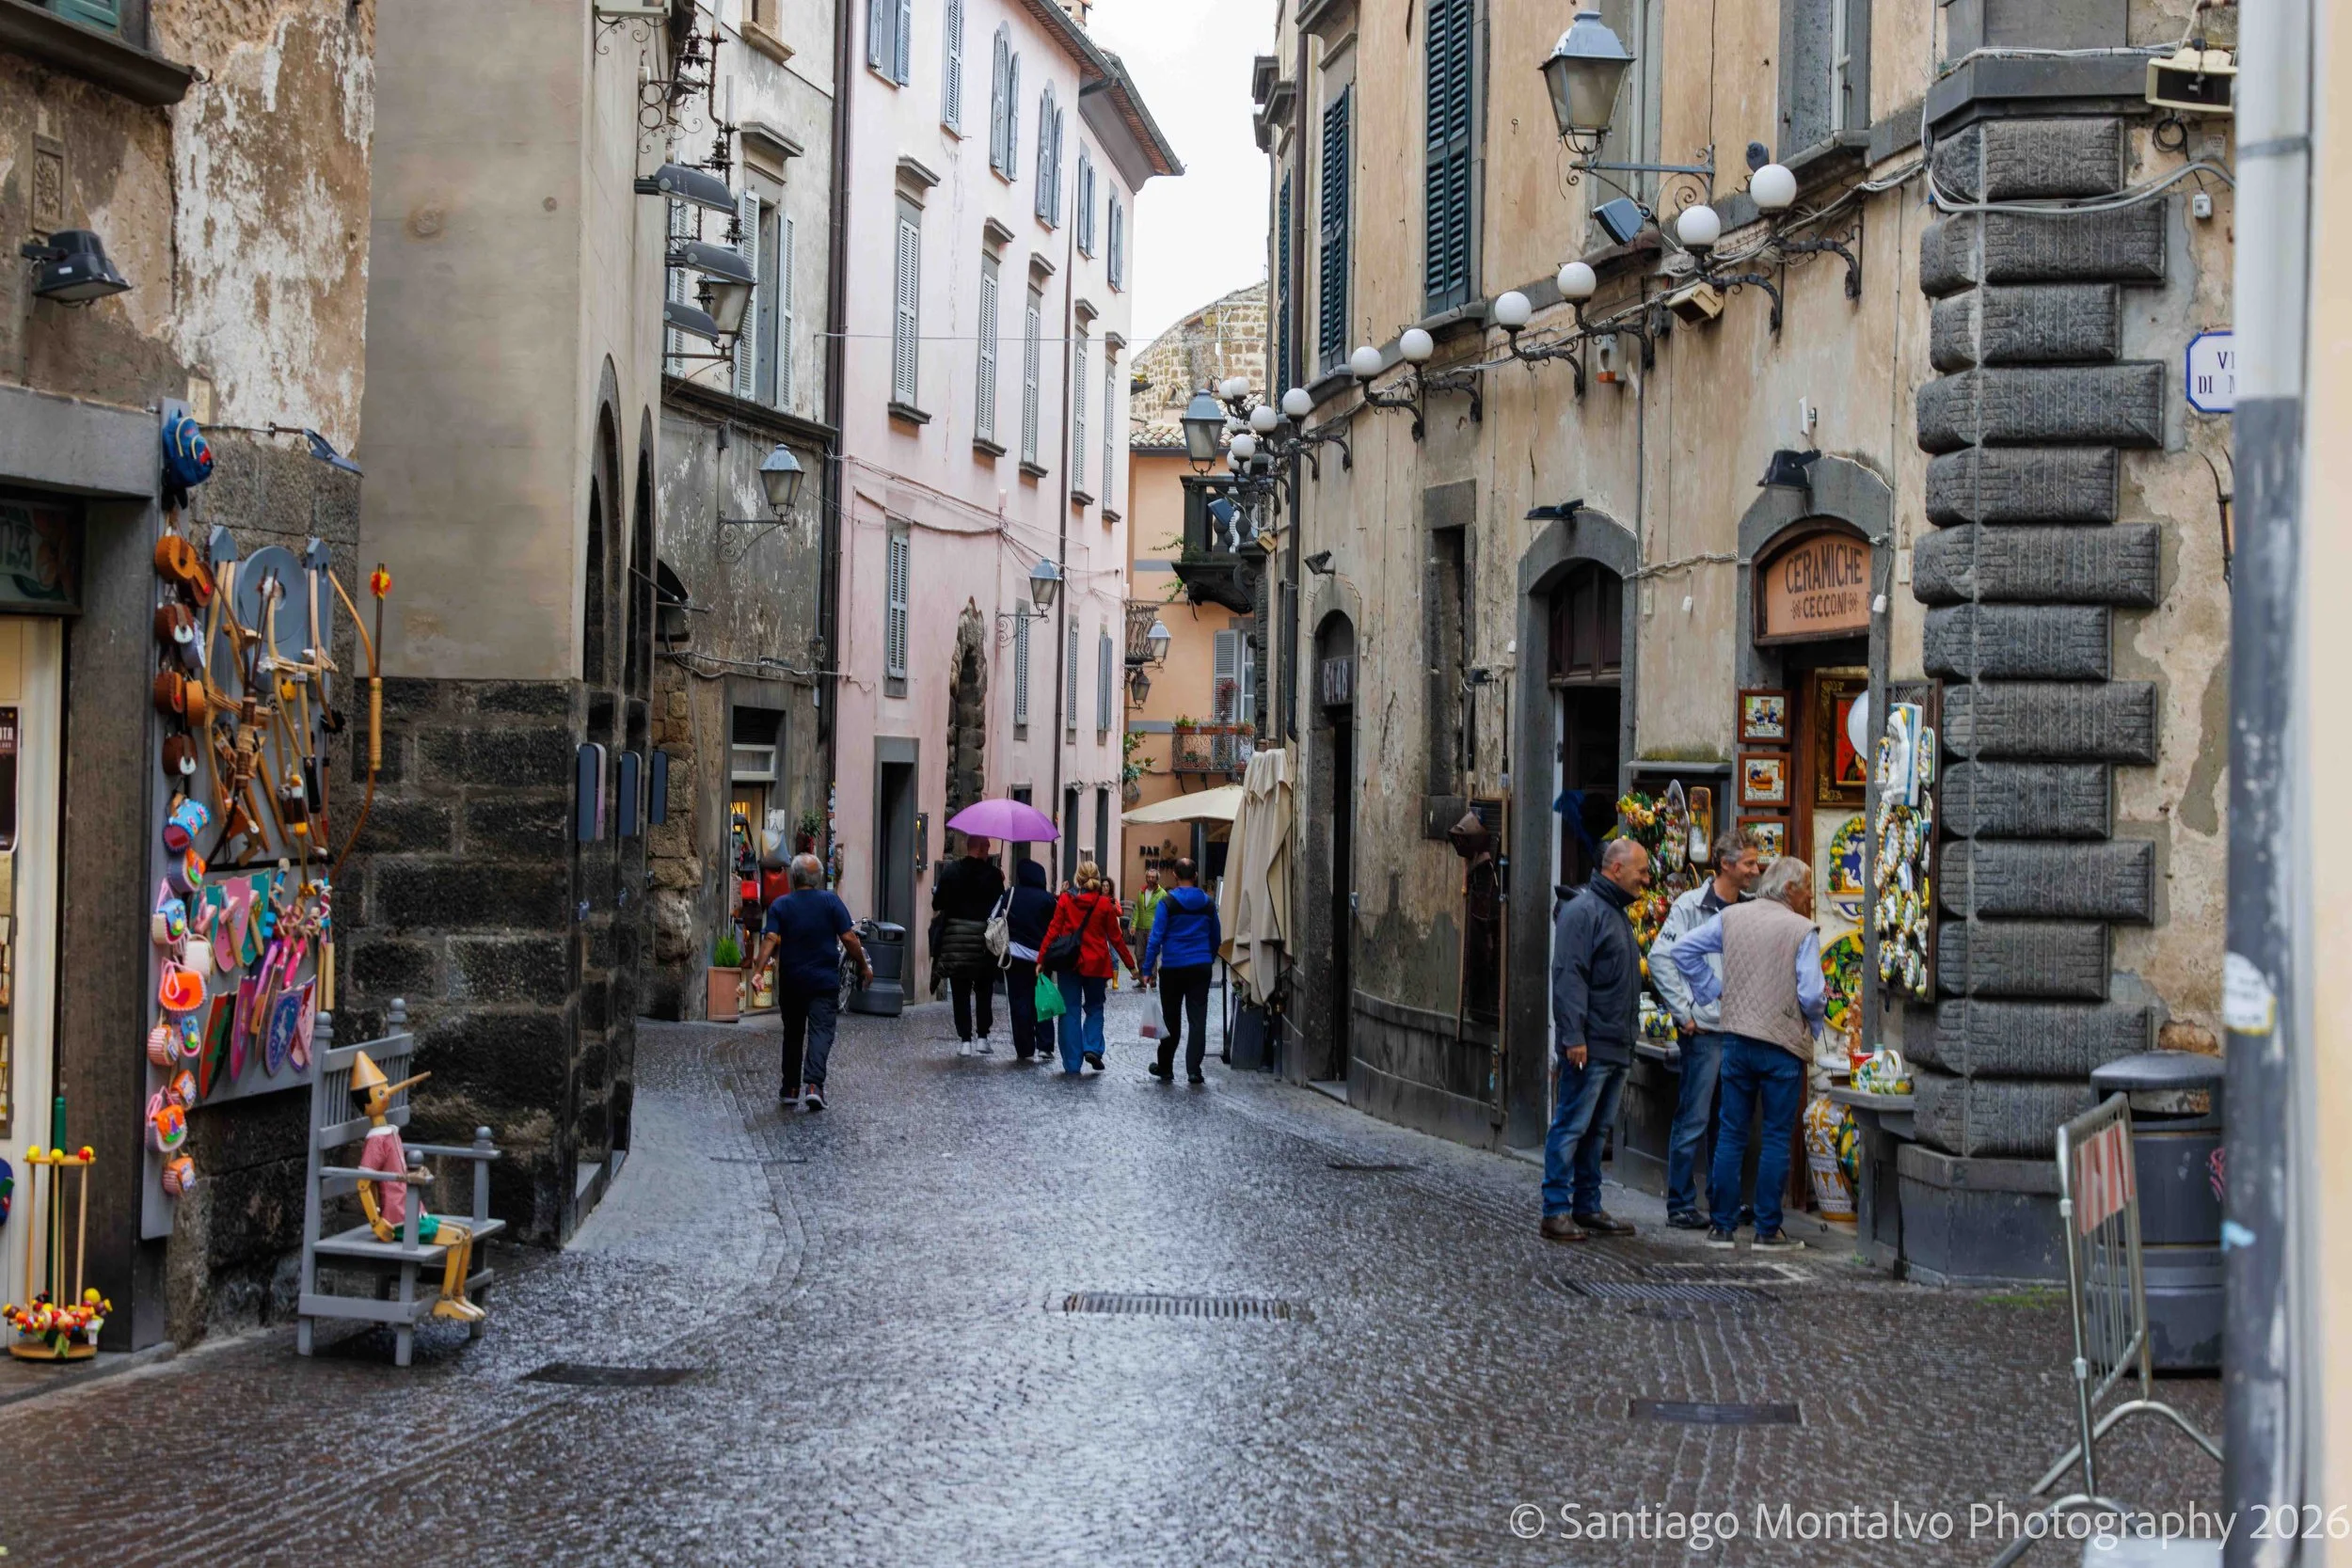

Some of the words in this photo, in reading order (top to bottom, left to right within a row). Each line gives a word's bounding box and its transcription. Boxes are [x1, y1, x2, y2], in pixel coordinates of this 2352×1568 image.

[2198, 374, 2213, 394] DI
[1786, 544, 1863, 594] CERAMICHE
[1804, 593, 1847, 618] CECCONI
[1139, 845, 1160, 857] BAR
